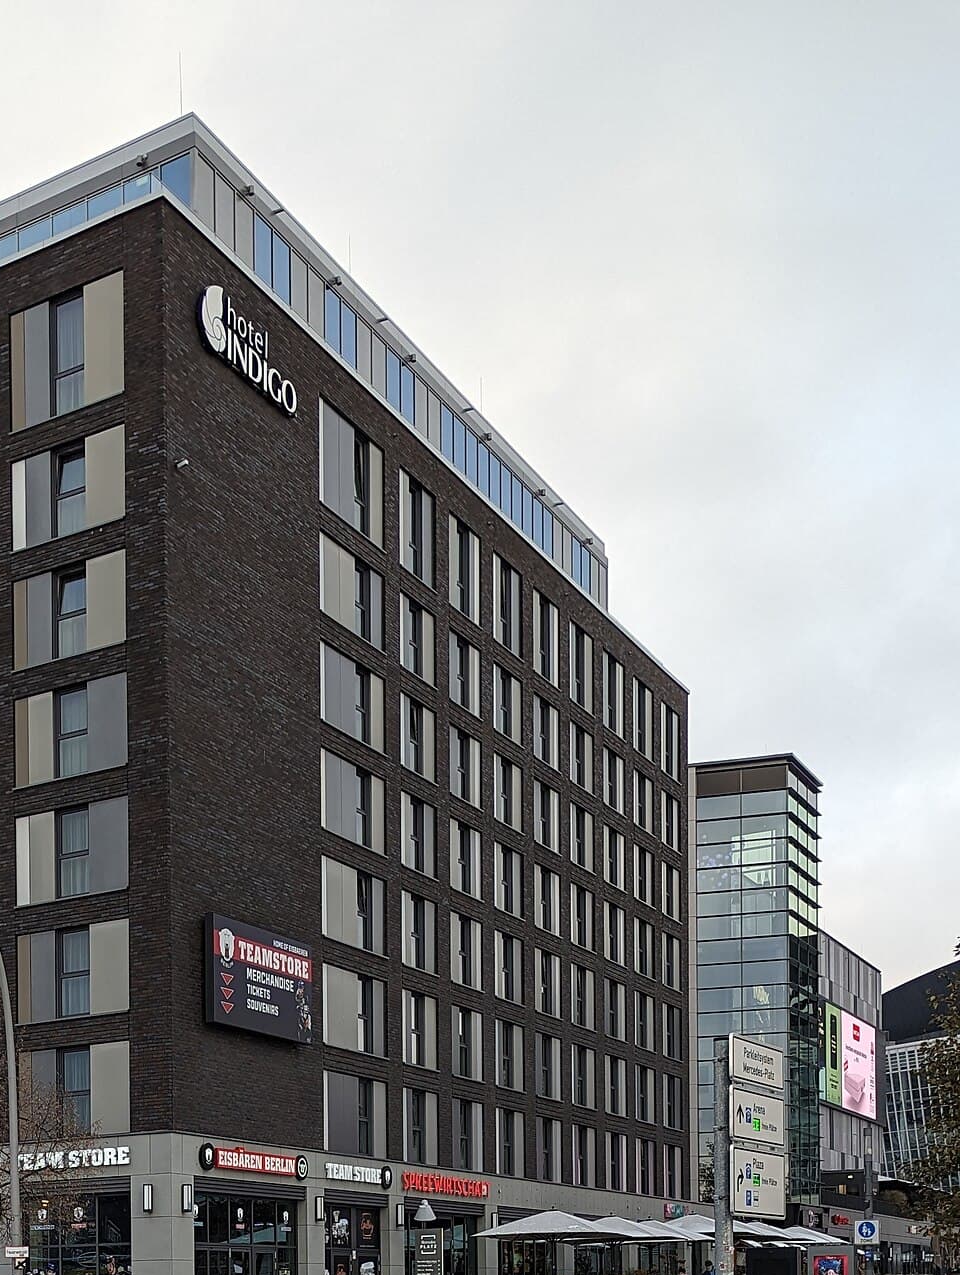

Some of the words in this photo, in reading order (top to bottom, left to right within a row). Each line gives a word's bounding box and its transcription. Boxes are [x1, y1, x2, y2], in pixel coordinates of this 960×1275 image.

[227, 295, 268, 360] hotel
[227, 327, 297, 413] INDIGO
[238, 940, 309, 979] TEAMSTORE
[246, 967, 295, 993] MERCHANDISE
[246, 983, 271, 1000] TICKETS
[246, 998, 279, 1017] SOUVENIRS
[743, 1046, 775, 1066] Parkleitsystem
[742, 1061, 776, 1081] Mercedes-Platz
[753, 1102, 767, 1116] Arena
[68, 1146, 130, 1168] STORE
[218, 1148, 263, 1170] EISBÄREN
[264, 1156, 296, 1173] BERLIN
[752, 1158, 765, 1170] Plaza
[325, 1162, 353, 1181] TEAM
[353, 1166, 382, 1185] STORE
